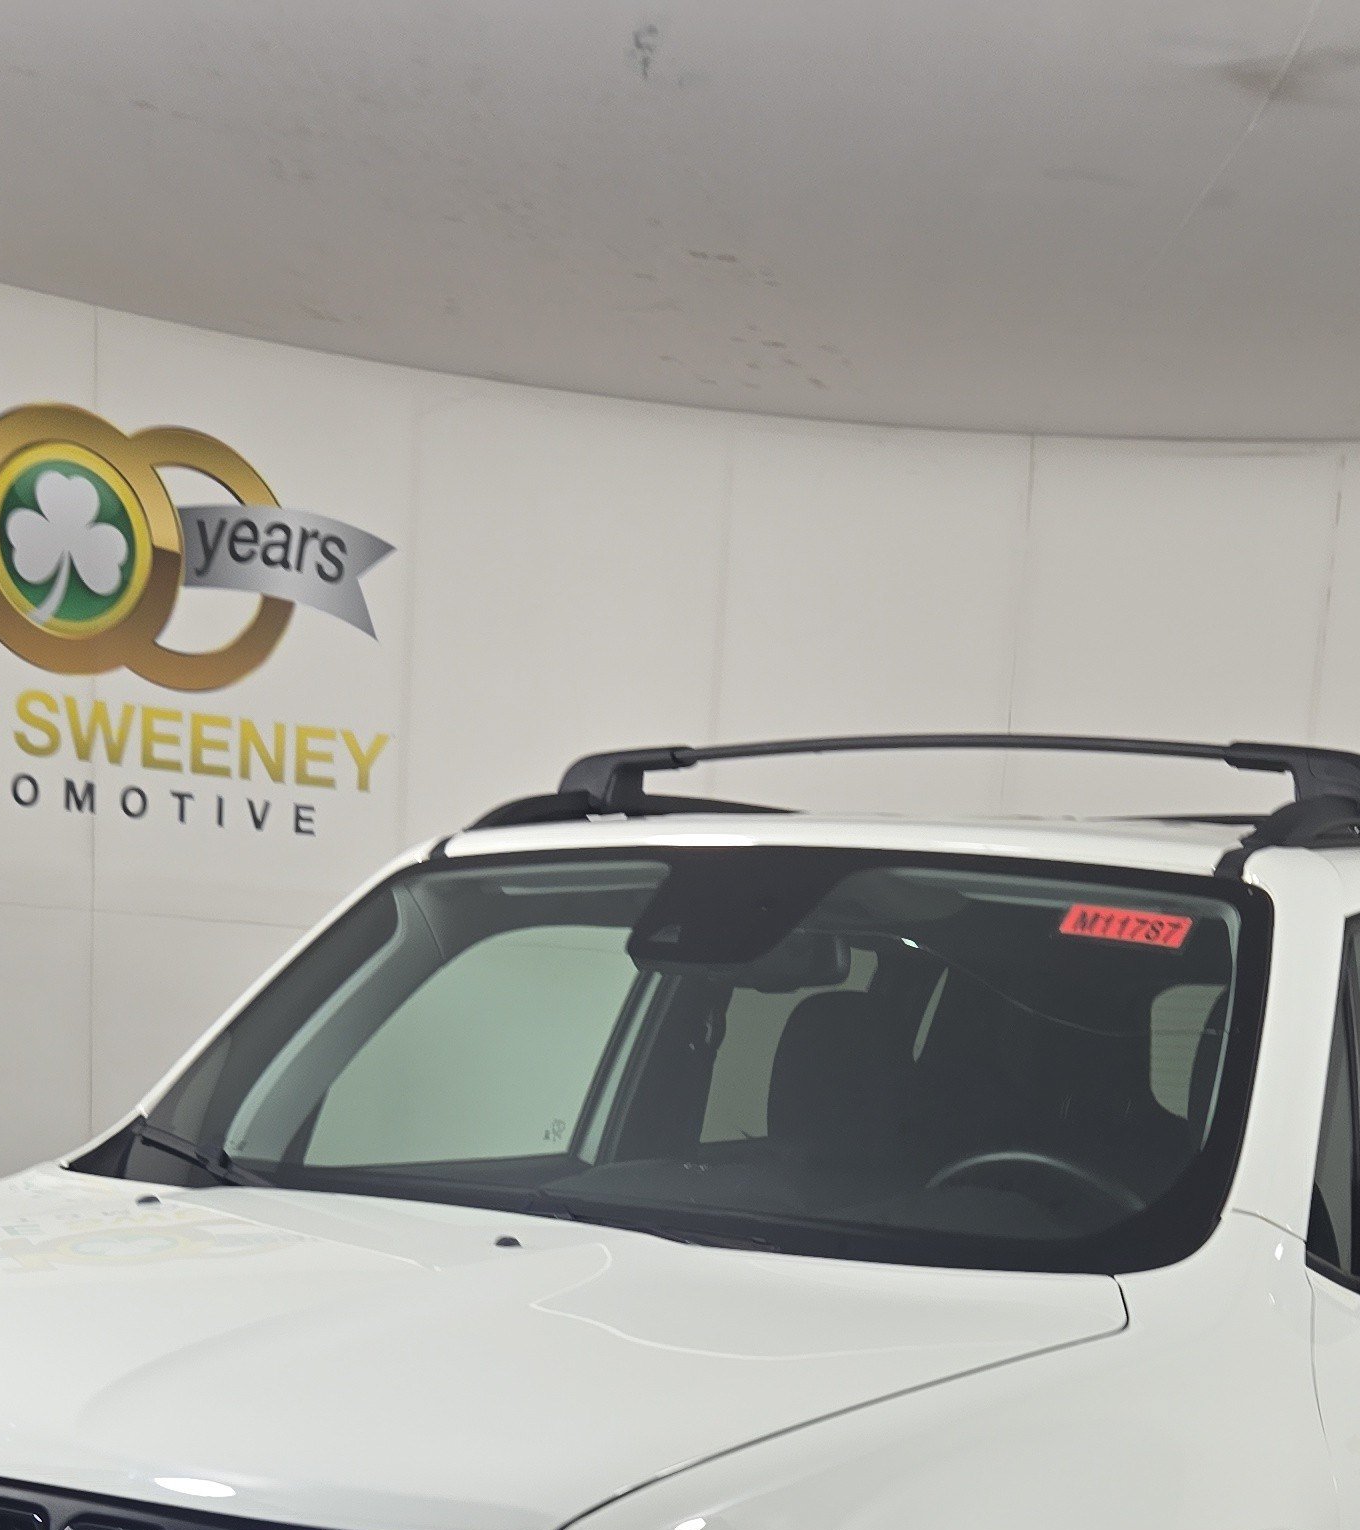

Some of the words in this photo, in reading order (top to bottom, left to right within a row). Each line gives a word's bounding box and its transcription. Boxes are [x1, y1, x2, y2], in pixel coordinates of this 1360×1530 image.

[194, 513, 348, 586] years
[13, 688, 391, 794] SWEENEY
[1072, 910, 1182, 946] M11787
